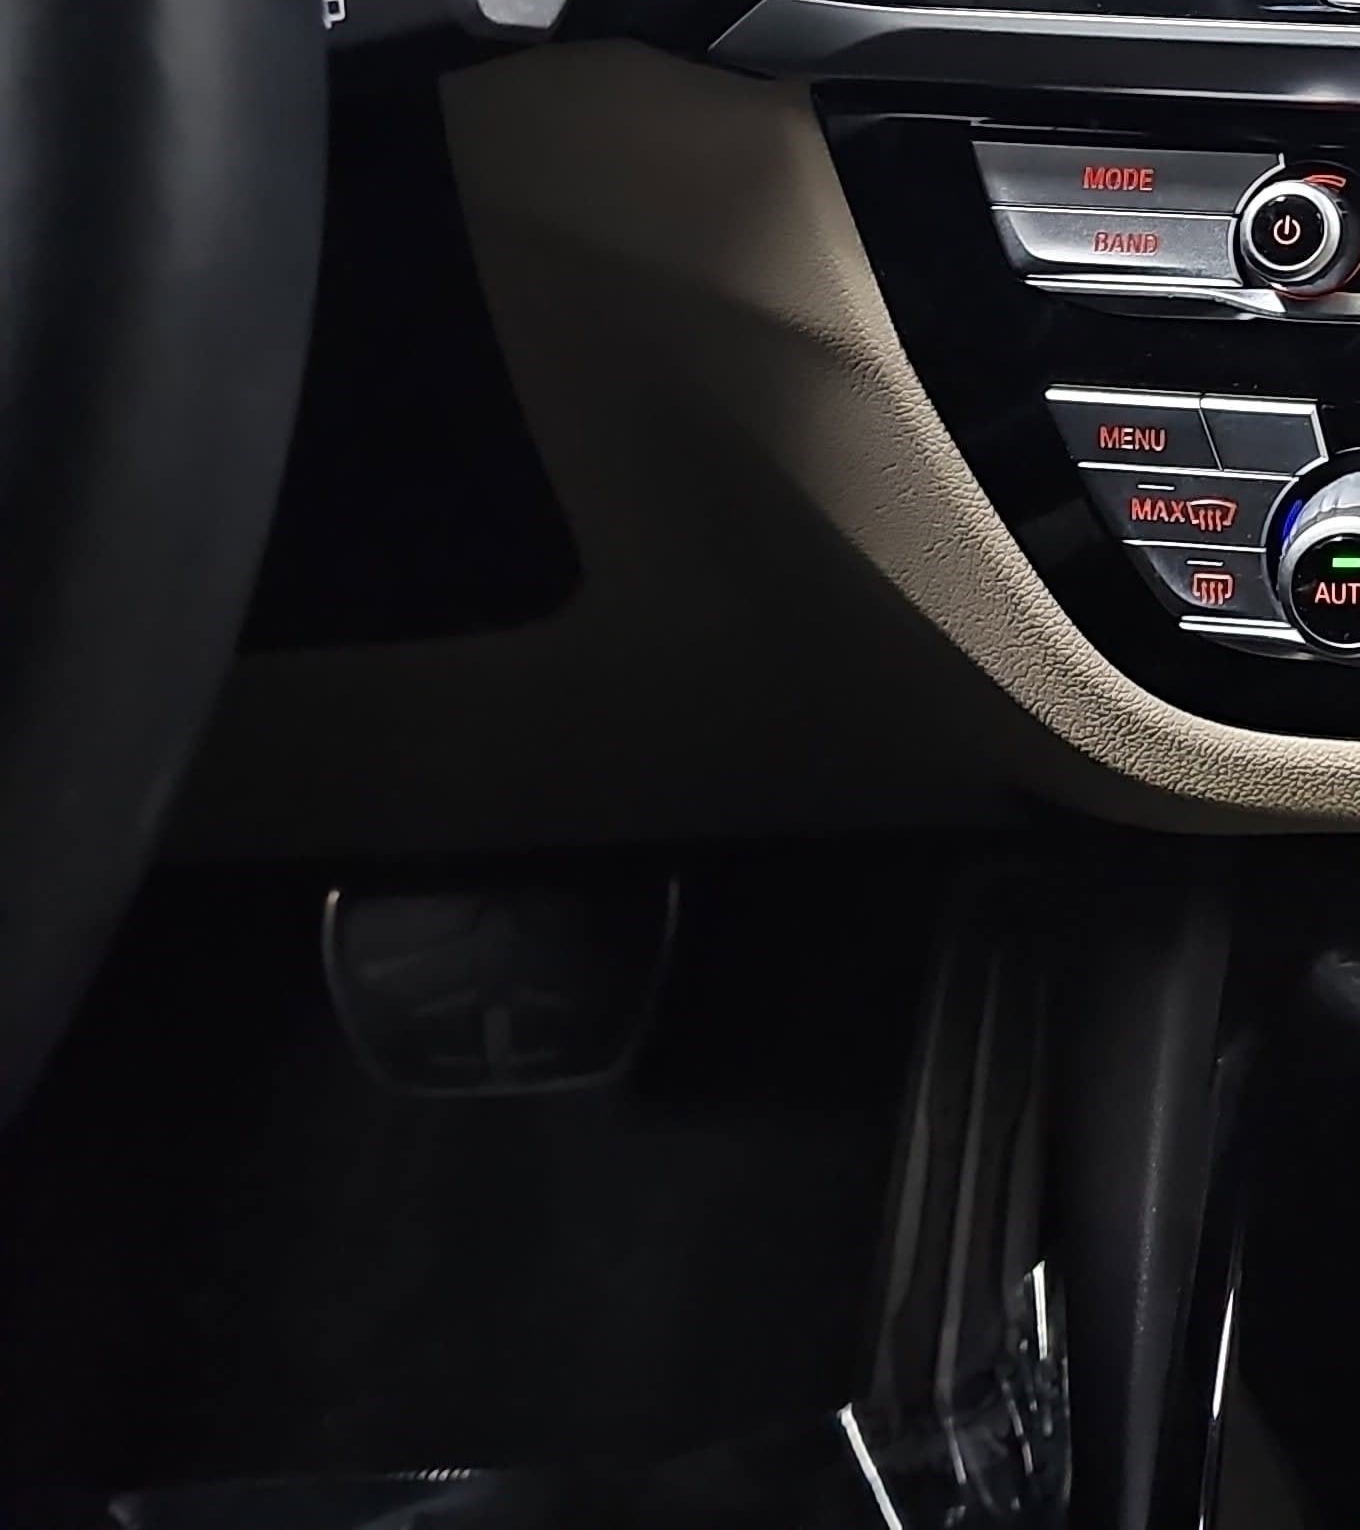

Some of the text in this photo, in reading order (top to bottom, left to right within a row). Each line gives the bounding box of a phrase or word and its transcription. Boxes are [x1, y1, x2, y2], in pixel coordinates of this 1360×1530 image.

[1082, 165, 1155, 193] MODE
[1093, 231, 1160, 257] BAND
[1098, 425, 1167, 452] MENU
[1129, 497, 1188, 523] MAX
